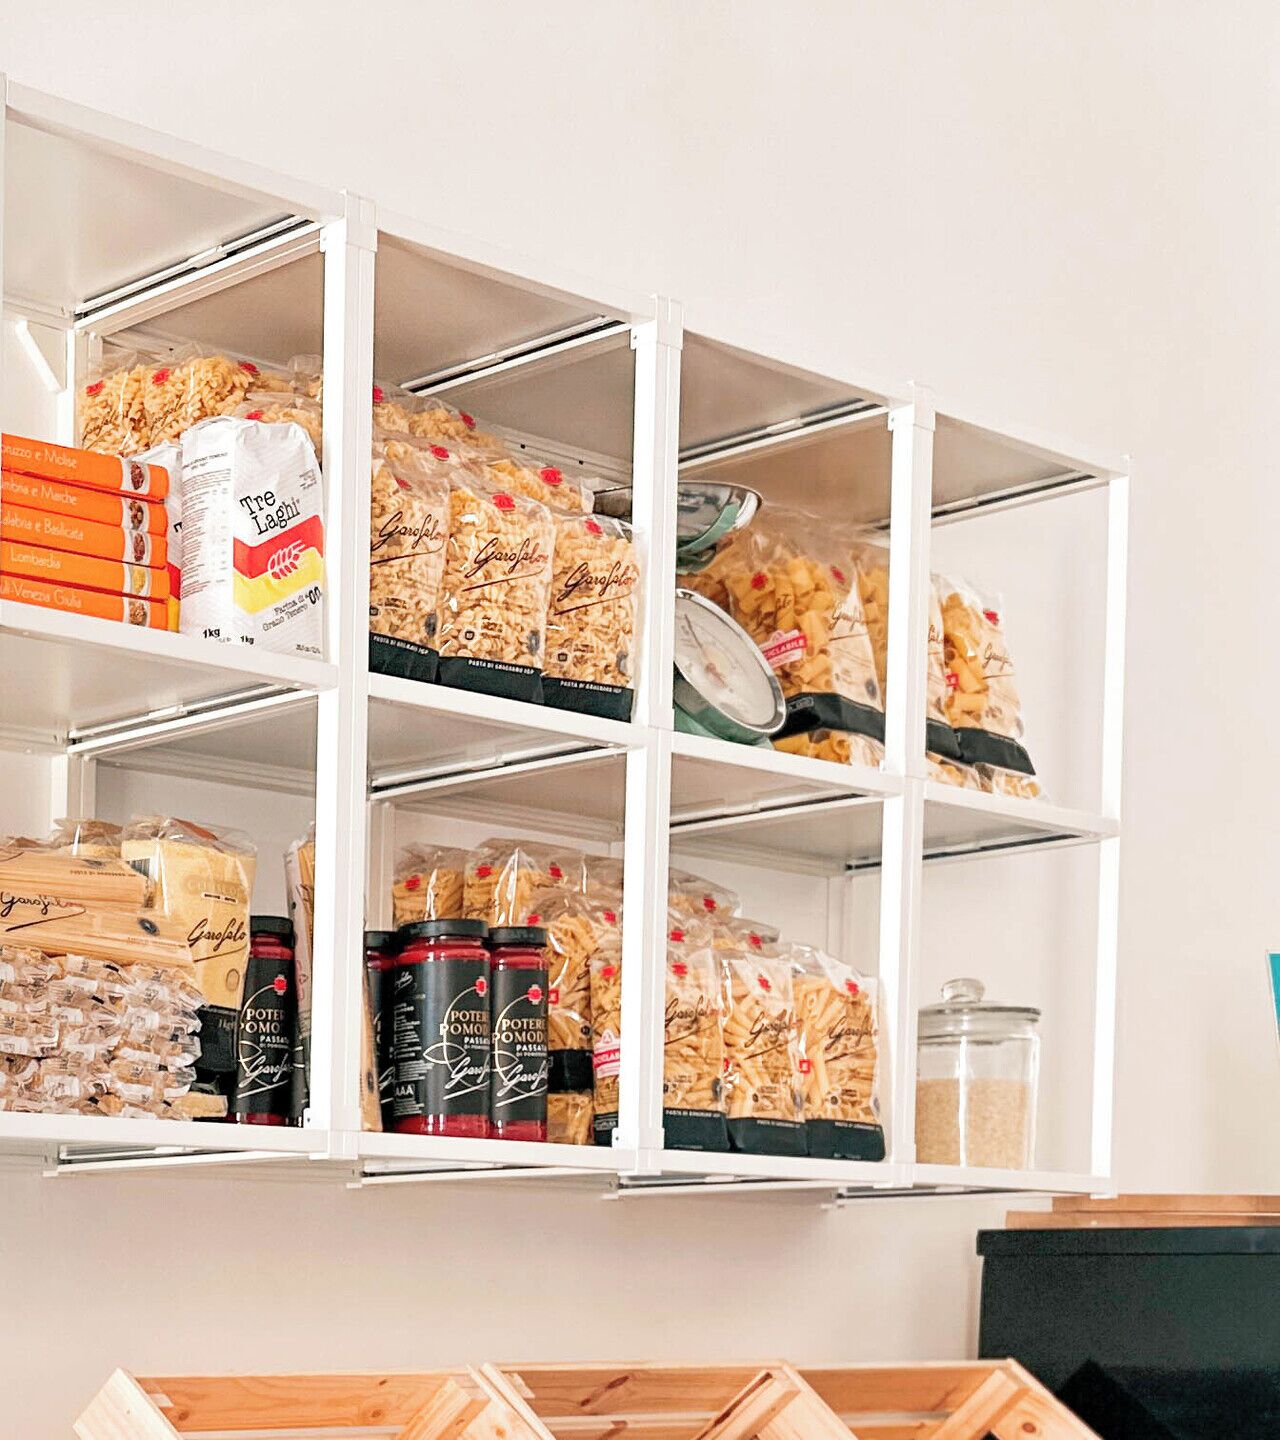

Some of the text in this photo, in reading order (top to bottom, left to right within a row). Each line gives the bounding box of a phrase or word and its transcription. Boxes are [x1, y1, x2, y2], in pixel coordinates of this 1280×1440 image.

[240, 490, 276, 516] Tre
[251, 496, 301, 535] Laghi
[203, 628, 220, 639] 1kg
[240, 636, 254, 645] 1kg
[187, 917, 248, 951] Garofalo
